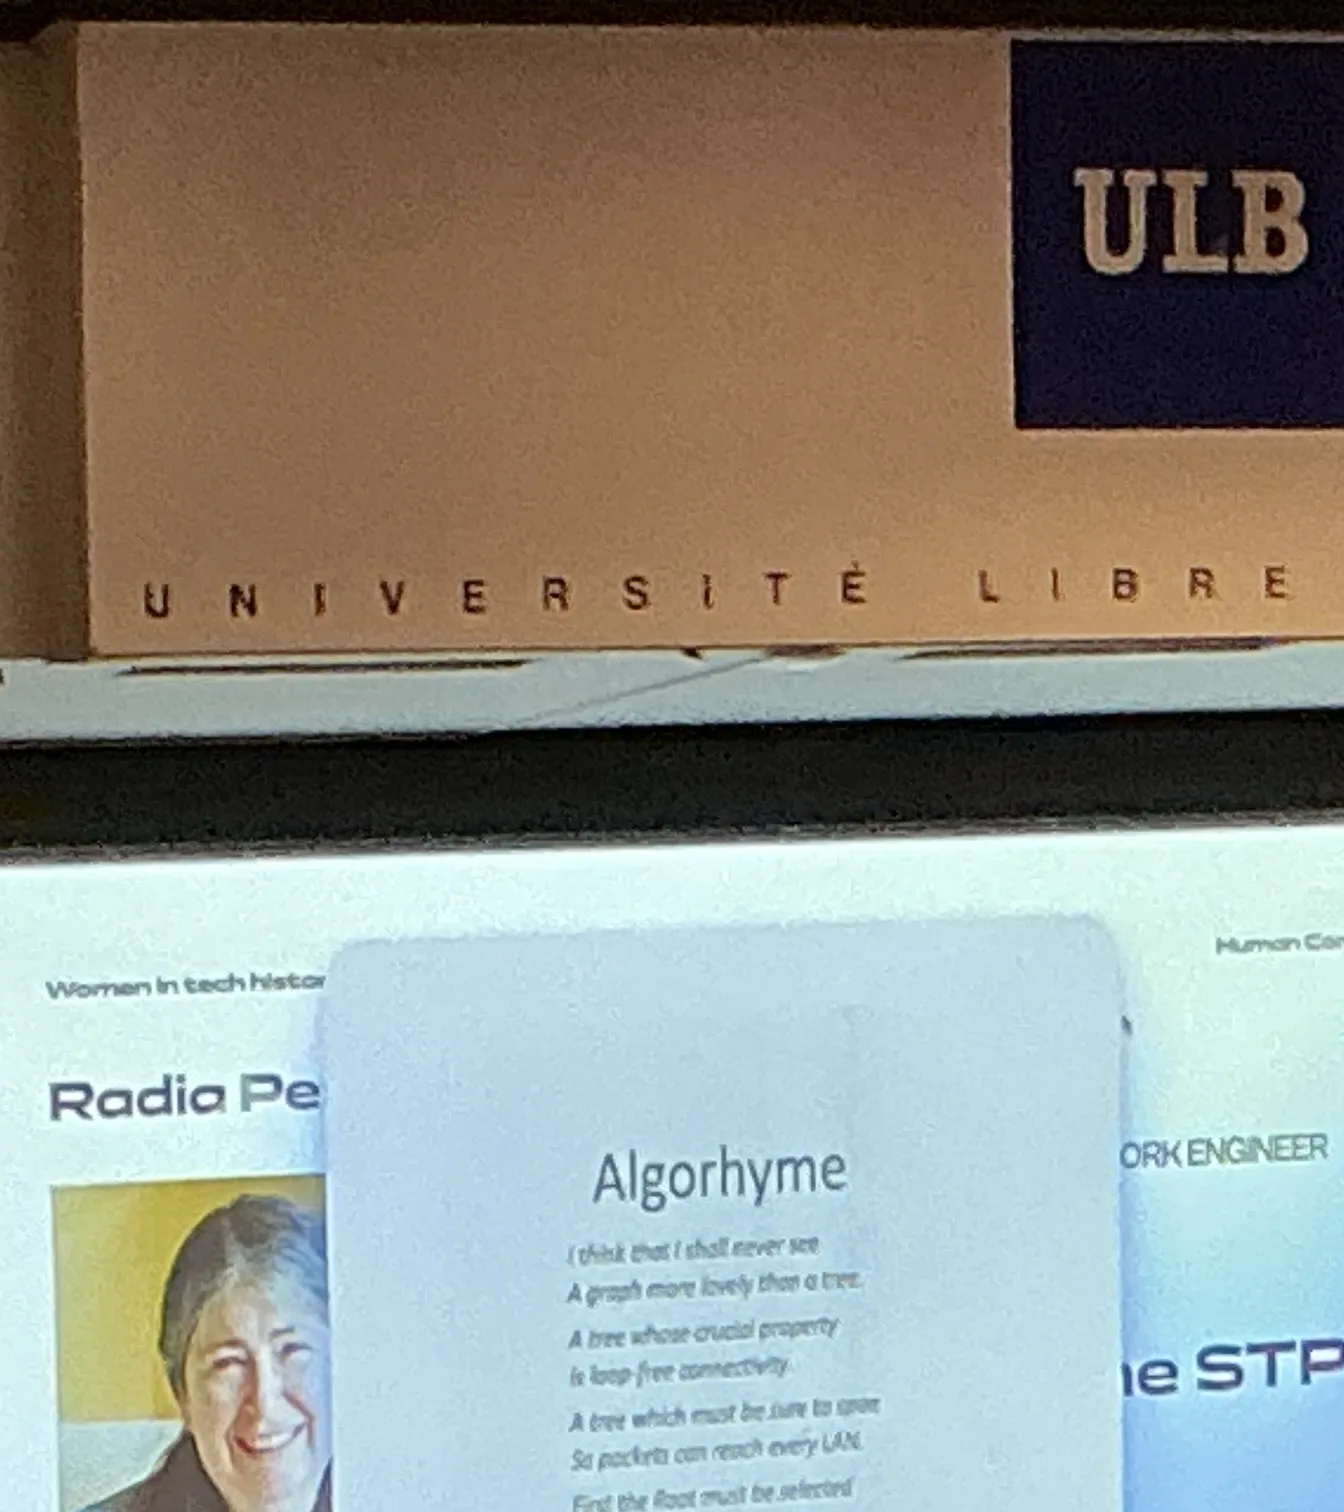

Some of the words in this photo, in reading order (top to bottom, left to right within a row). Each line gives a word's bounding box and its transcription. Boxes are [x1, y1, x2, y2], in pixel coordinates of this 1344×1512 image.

[1074, 167, 1309, 276] ULB
[144, 560, 868, 619] UNIVERSITÉ
[977, 564, 1289, 603] LIBRE
[1216, 936, 1301, 955] Human
[45, 979, 152, 999] Women
[156, 976, 180, 994] in
[183, 972, 246, 994] tech
[49, 1073, 227, 1121] Radia
[240, 1072, 321, 1112] Pe
[1119, 1139, 1183, 1169] ORK
[1187, 1132, 1330, 1167] ENGINEER
[592, 1144, 849, 1213] Algorhyme
[579, 1243, 626, 1265] think
[631, 1243, 669, 1263] that
[685, 1237, 729, 1260] shall
[733, 1239, 786, 1257] never
[567, 1282, 582, 1303] A
[568, 1330, 582, 1349] A
[569, 1411, 584, 1432] A
